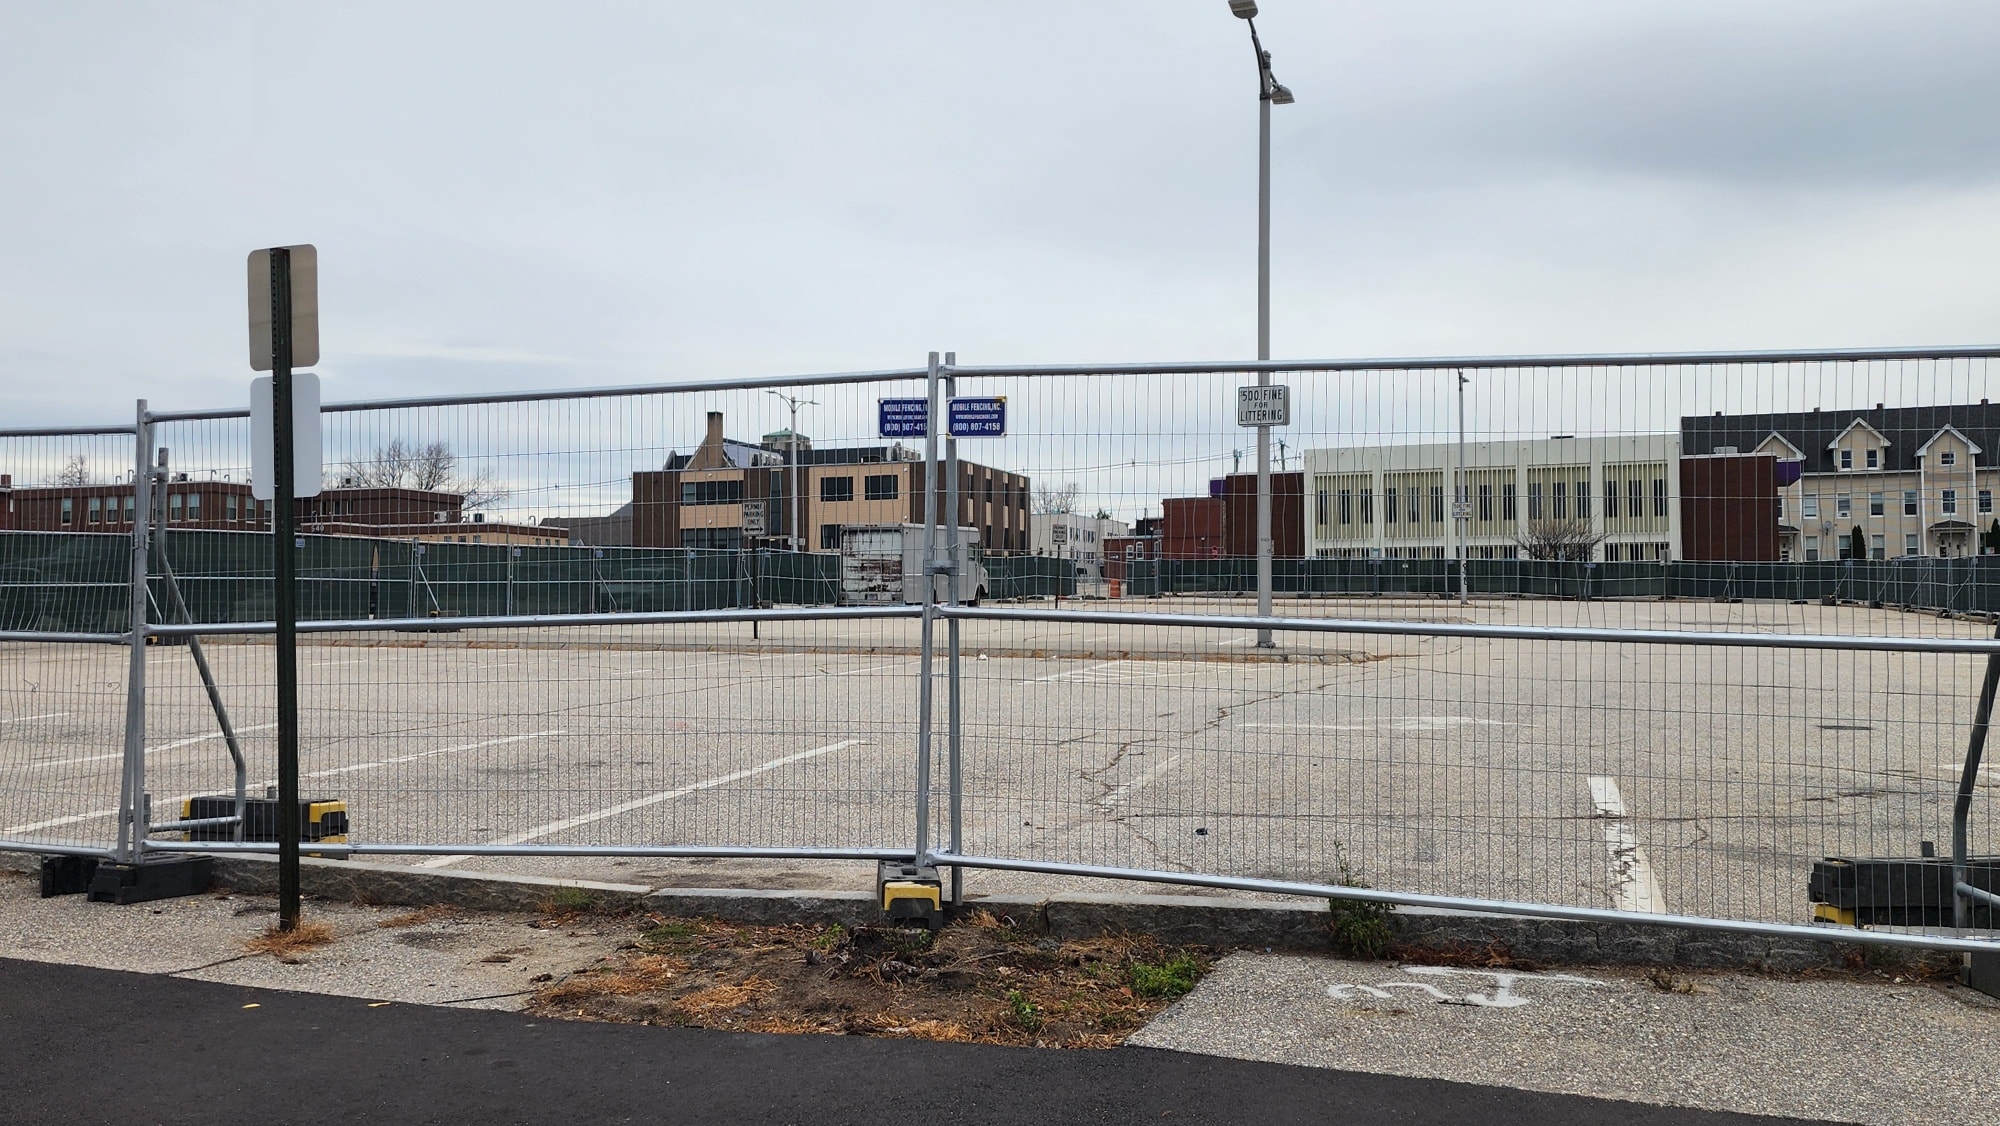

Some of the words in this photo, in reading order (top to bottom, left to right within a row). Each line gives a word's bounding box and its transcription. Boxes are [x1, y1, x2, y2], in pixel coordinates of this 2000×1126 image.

[1264, 390, 1282, 400] FINE
[884, 404, 901, 412] MOBILE
[952, 403, 970, 411] MOBILE
[1241, 409, 1282, 421] LITTERING
[884, 423, 901, 432] (800)
[952, 422, 969, 432] (800)
[970, 422, 1001, 431] 807-4158
